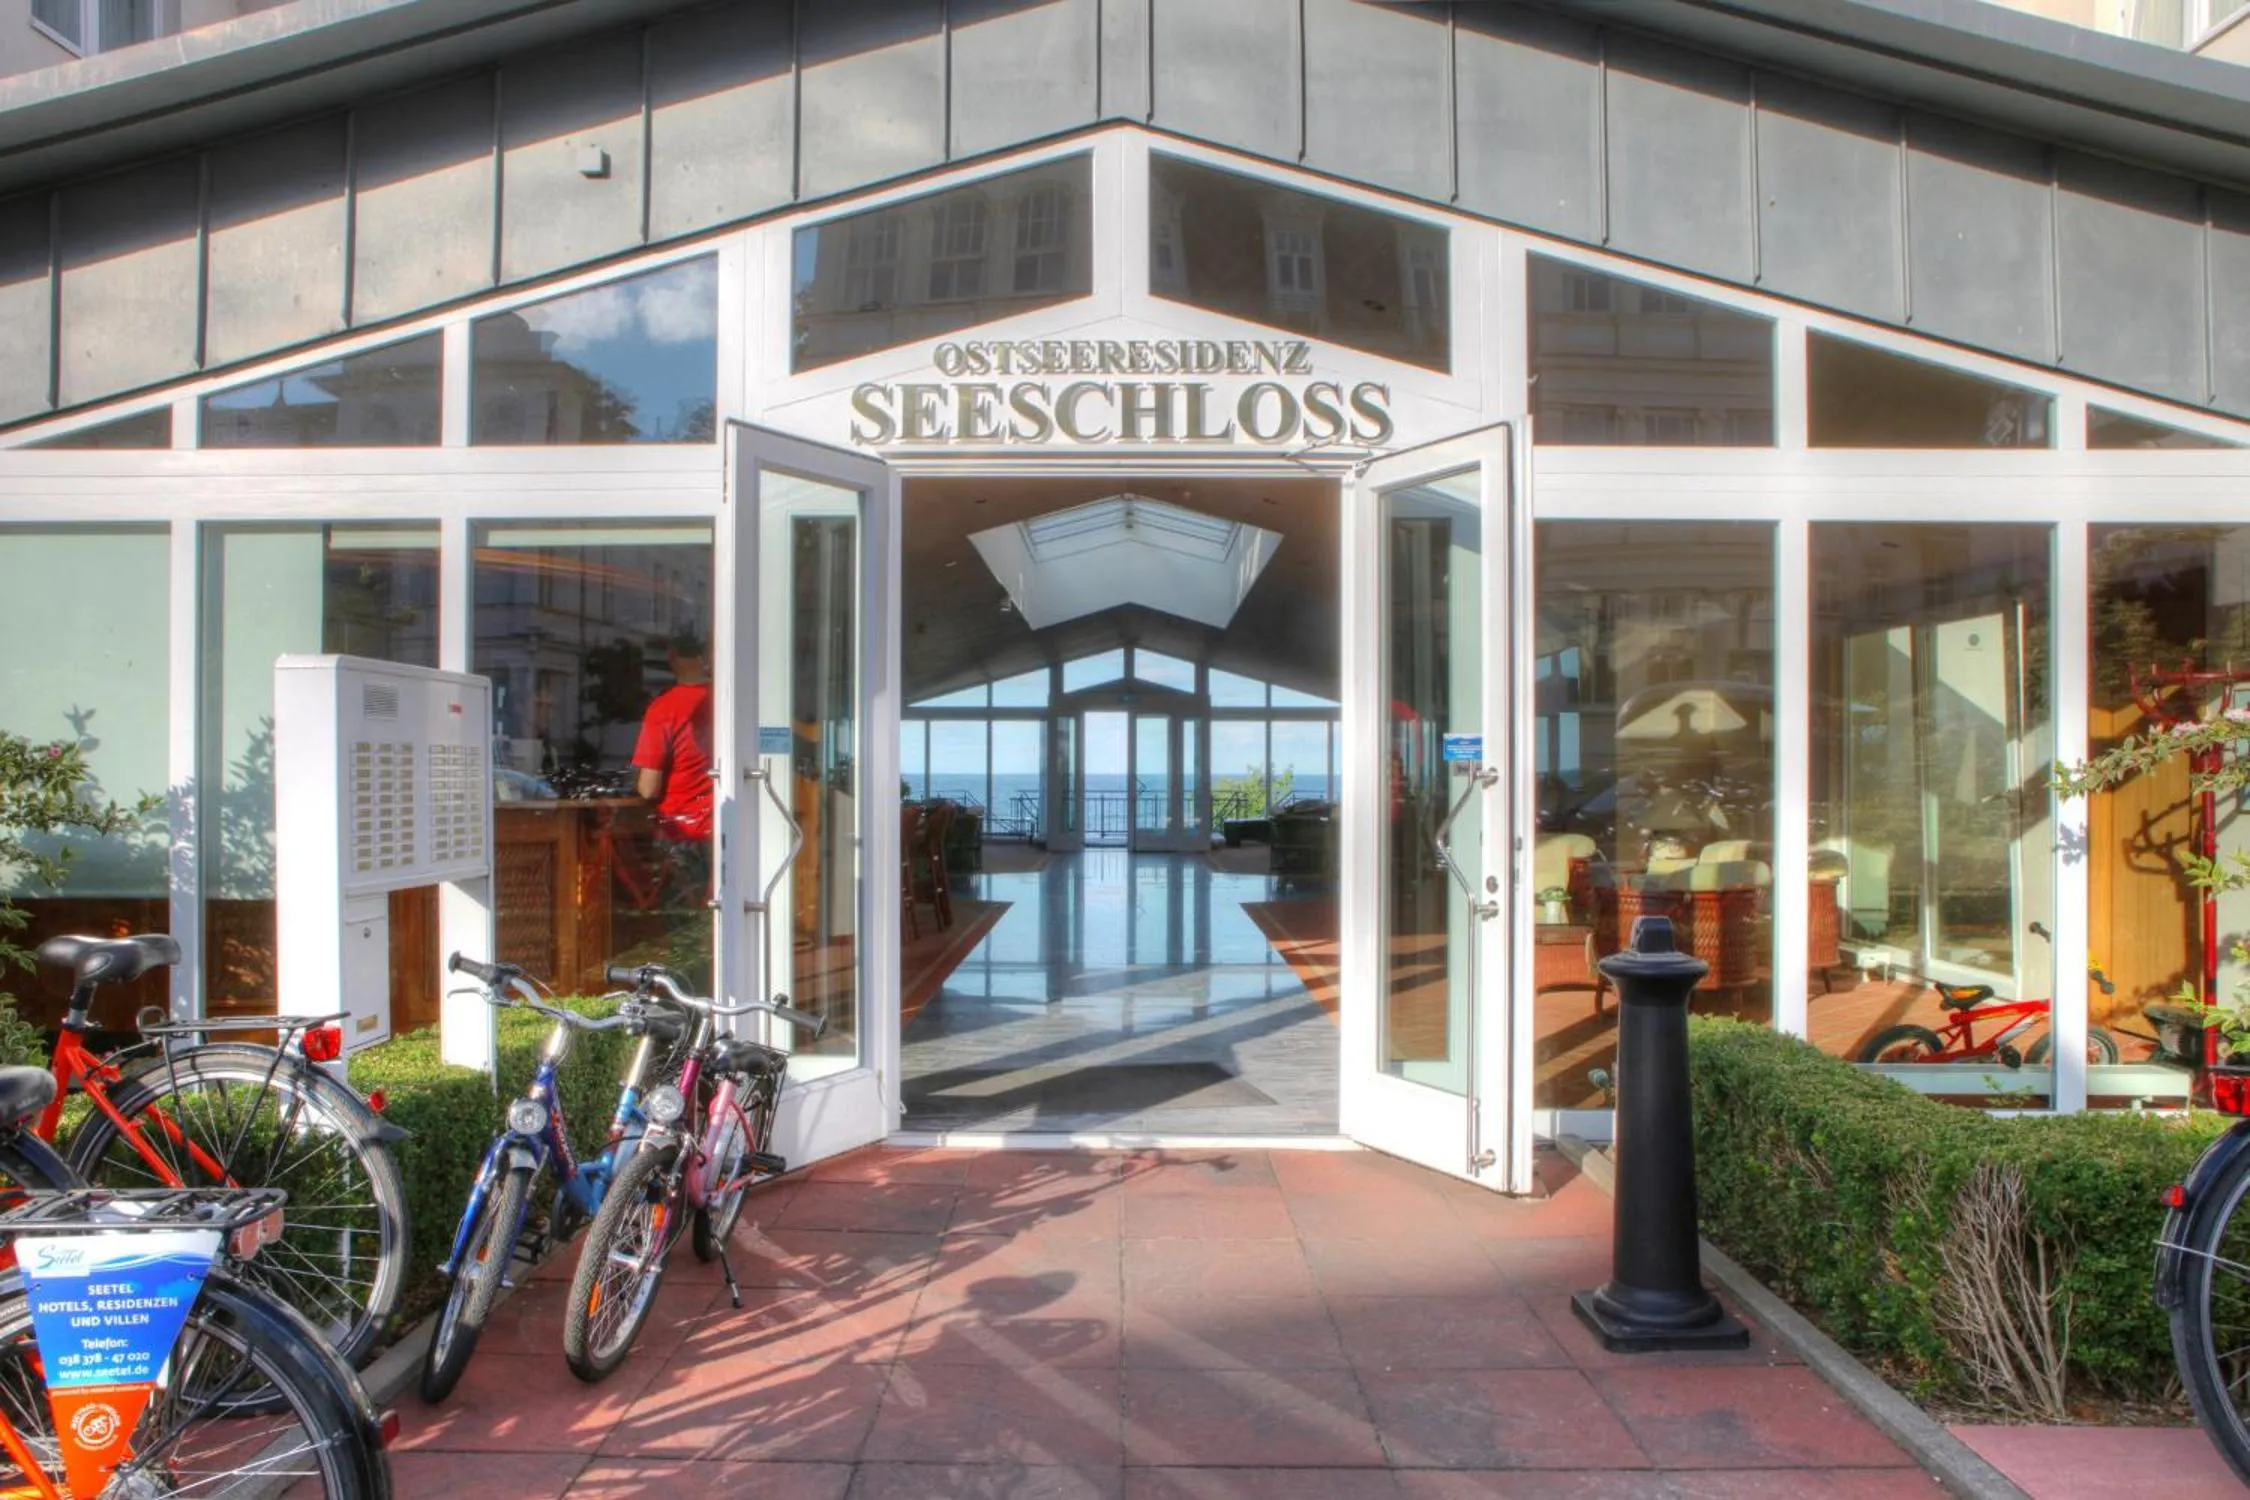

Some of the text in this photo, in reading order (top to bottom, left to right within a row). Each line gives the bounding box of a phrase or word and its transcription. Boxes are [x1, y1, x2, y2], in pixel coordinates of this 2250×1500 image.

[934, 339, 1313, 377] OSTSEERESIDENZ
[849, 381, 1395, 446] SEESCHLOSS
[87, 1284, 134, 1296] SEETEL
[38, 1301, 93, 1313] HOTELS,
[97, 1297, 179, 1311] RESIDENZEN
[71, 1314, 150, 1328] UND VILLEN
[81, 1338, 129, 1350] Telefon:
[58, 1365, 150, 1379] www.seetel.de
